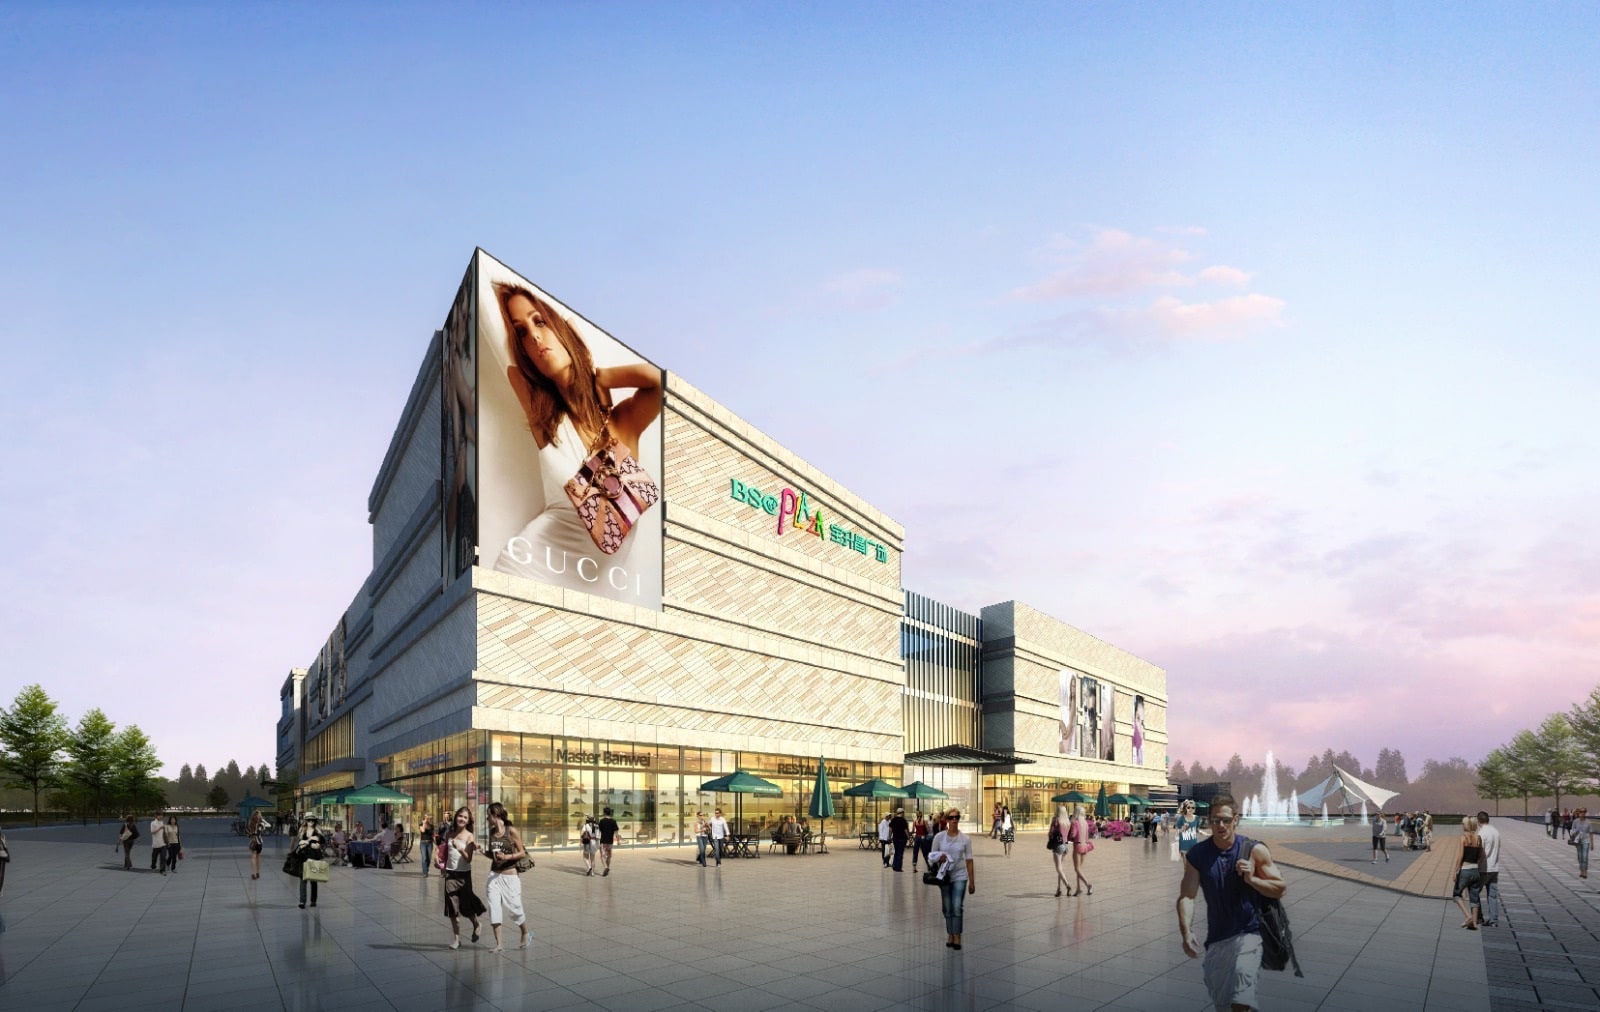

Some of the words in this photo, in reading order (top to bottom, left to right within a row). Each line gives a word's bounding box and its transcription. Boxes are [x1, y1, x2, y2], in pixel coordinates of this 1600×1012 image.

[507, 536, 640, 596] GUCCI
[556, 748, 600, 764] Master
[603, 751, 651, 767] Banwei
[777, 763, 848, 777] RESTAUANT
